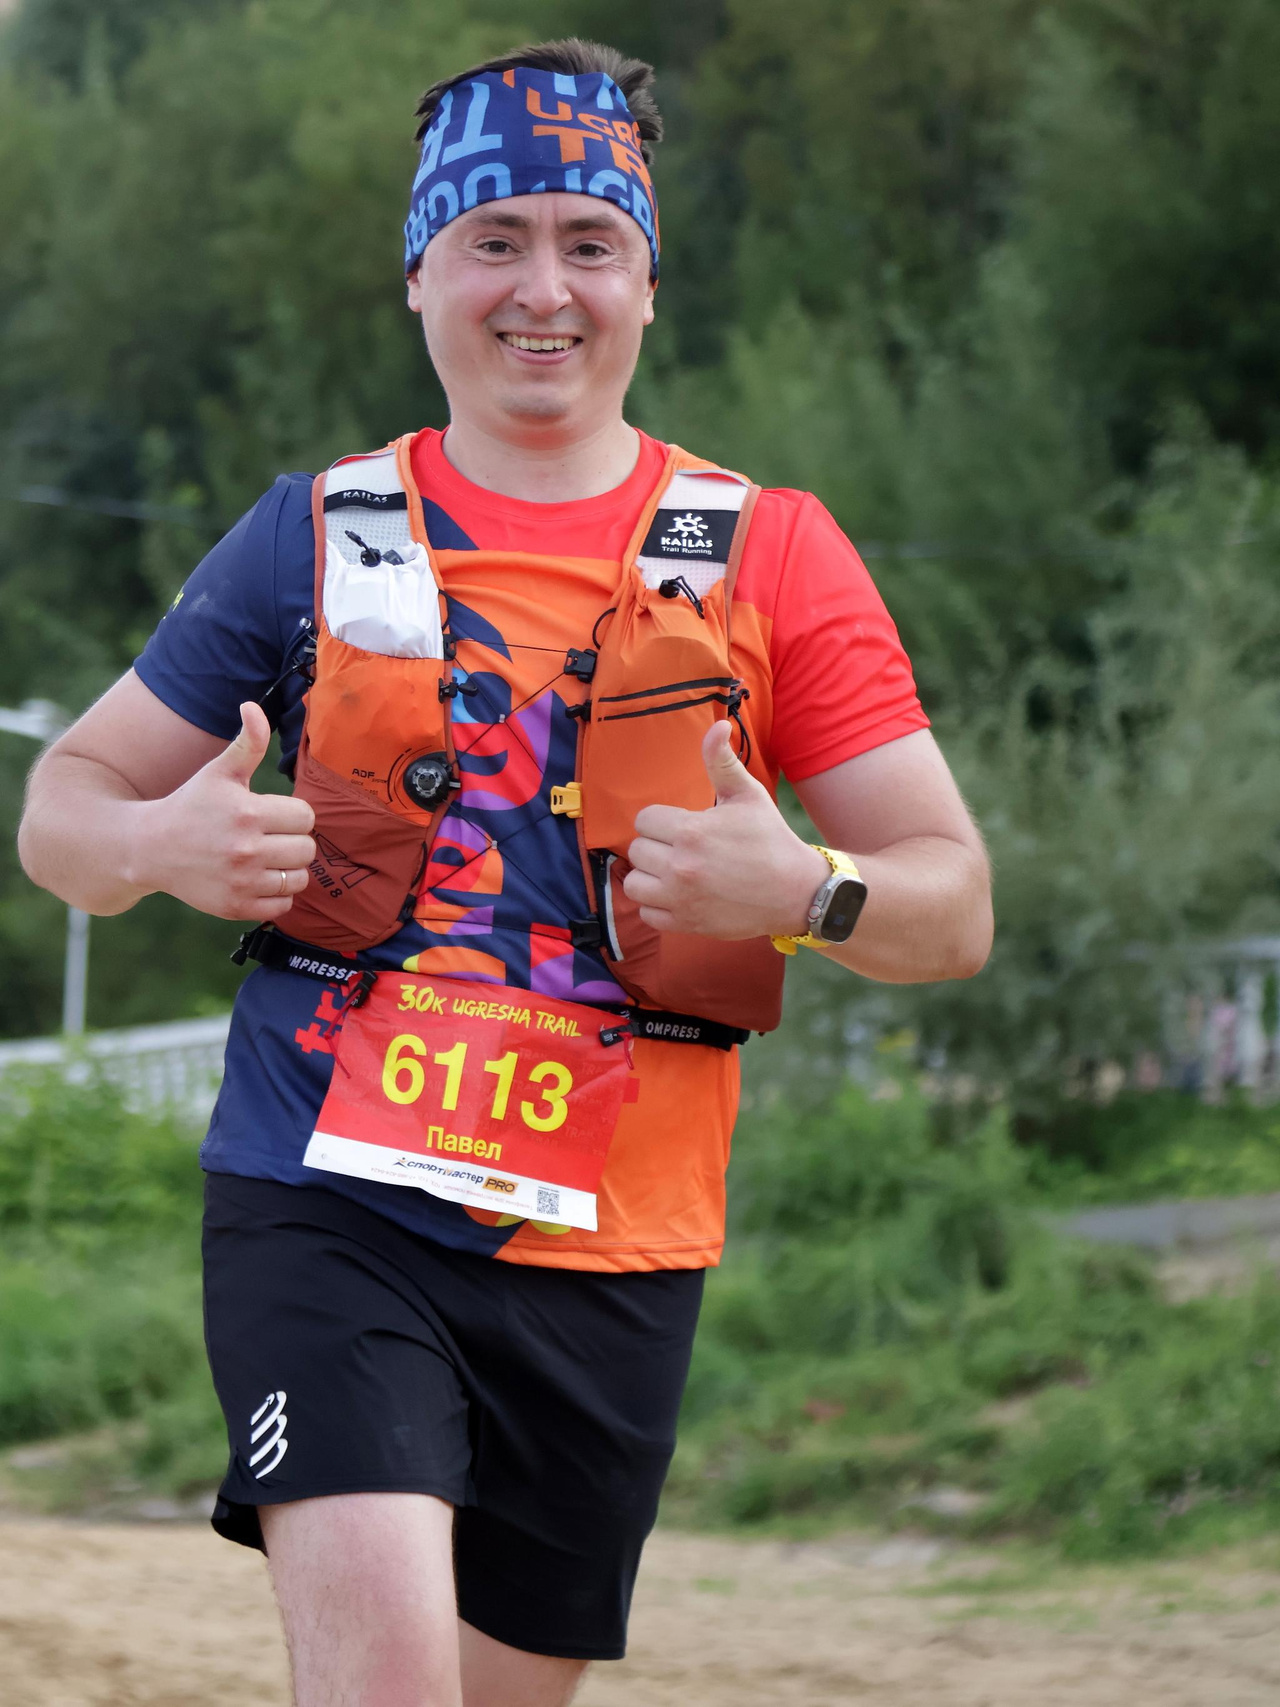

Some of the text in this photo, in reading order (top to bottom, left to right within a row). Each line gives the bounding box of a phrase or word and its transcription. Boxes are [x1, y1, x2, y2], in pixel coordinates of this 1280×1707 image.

[342, 490, 388, 503] KAILAS
[660, 536, 713, 548] KAILAS
[682, 547, 712, 556] Running
[351, 768, 376, 779] ADF
[452, 998, 531, 1029] UGRESHA
[536, 1010, 582, 1038] TRAIL
[382, 1033, 573, 1132] 6113
[426, 1125, 503, 1161] Павел
[485, 1178, 515, 1193] PRO
